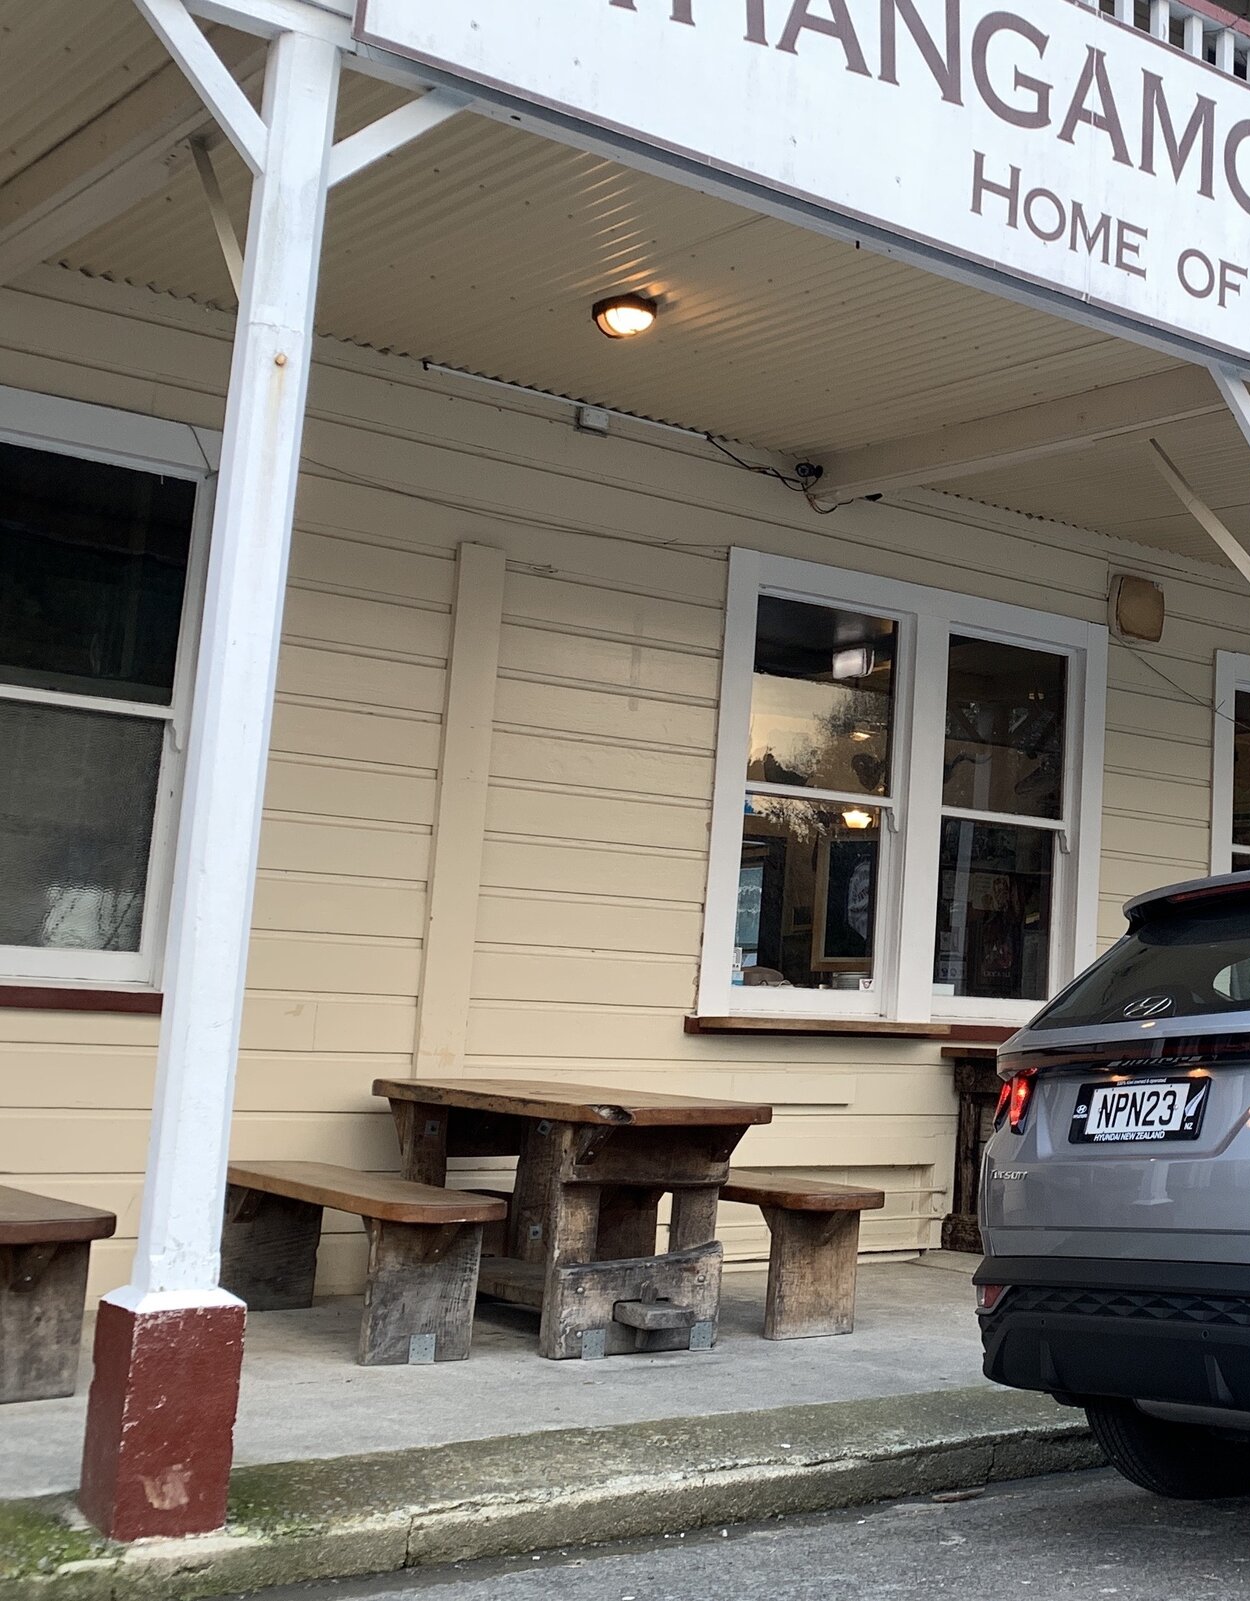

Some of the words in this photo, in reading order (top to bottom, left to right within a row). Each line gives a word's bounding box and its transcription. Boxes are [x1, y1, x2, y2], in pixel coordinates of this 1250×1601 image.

[972, 150, 1148, 279] HOME
[1177, 247, 1249, 308] OF
[1096, 1090, 1177, 1129] NPN23
[1093, 1132, 1120, 1142] HYUNDAI
[1120, 1131, 1136, 1141] NEW
[1135, 1130, 1166, 1140] ZEALAND
[1184, 1122, 1194, 1131] NZ
